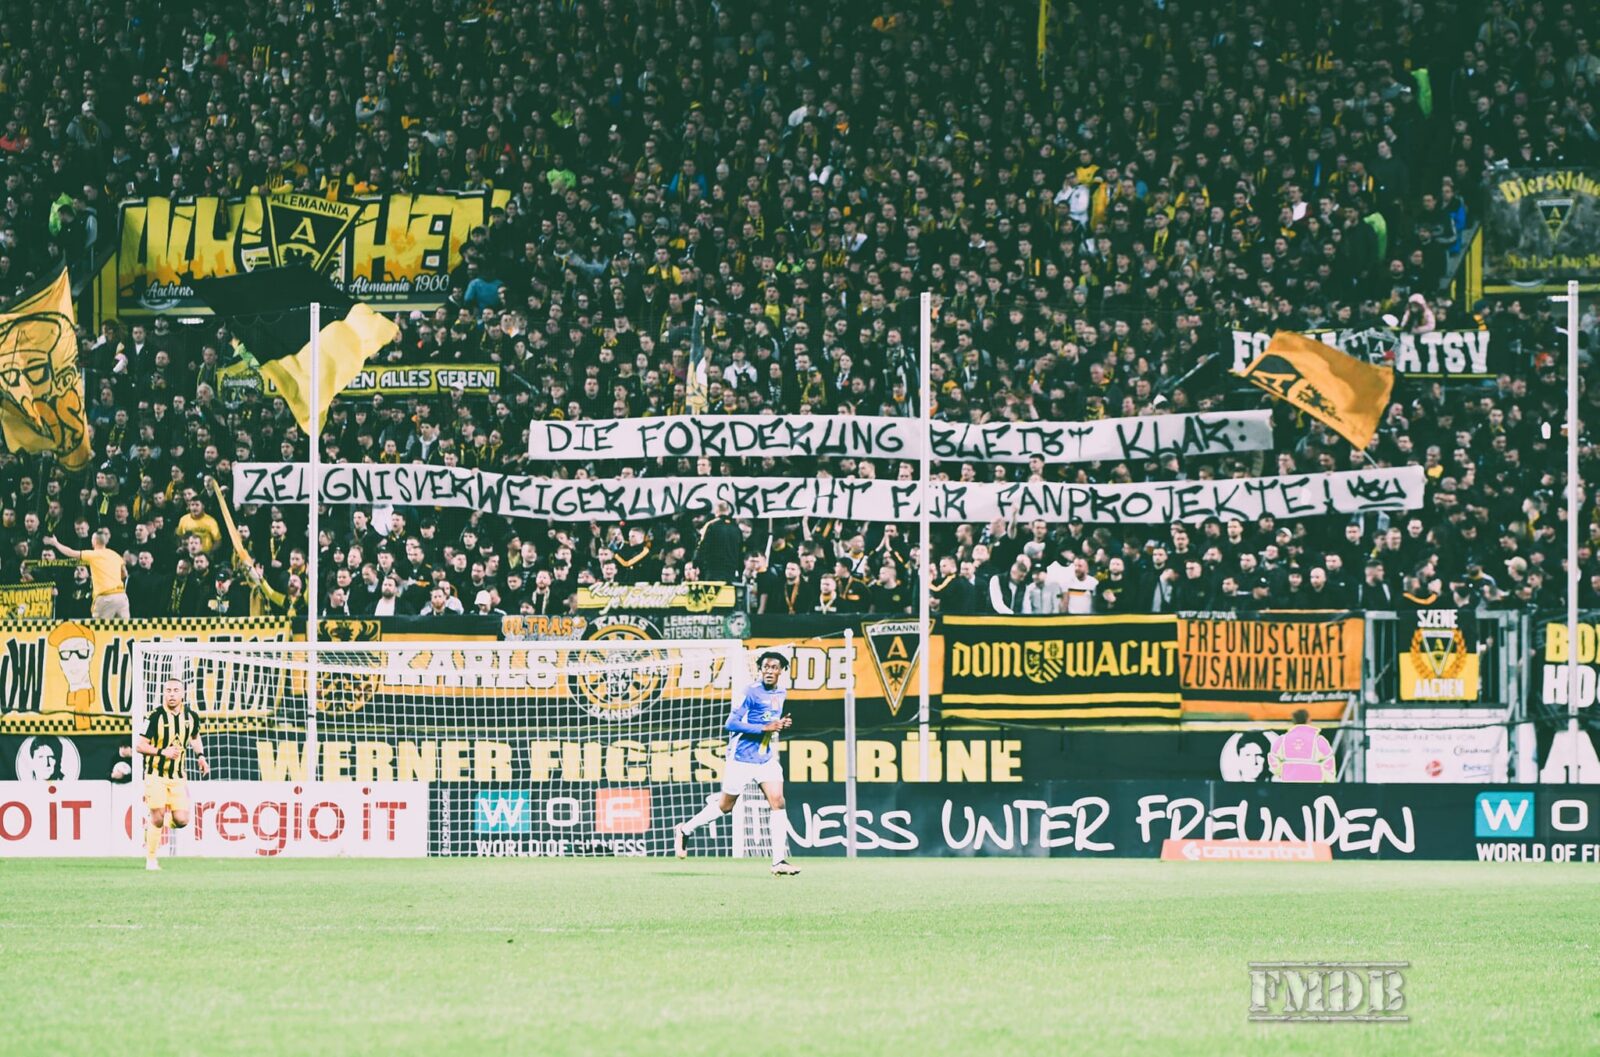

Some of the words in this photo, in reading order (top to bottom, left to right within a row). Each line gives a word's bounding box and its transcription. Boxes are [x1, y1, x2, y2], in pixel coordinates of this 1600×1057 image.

[271, 194, 350, 217] ALEMANNIA
[289, 216, 316, 244] A
[348, 276, 410, 294] Alemannia
[414, 274, 449, 292] 1900
[1396, 330, 1490, 373] ATSV
[380, 370, 430, 388] ALLES
[436, 370, 496, 388] GEBEN!
[546, 421, 619, 453] DIE
[639, 417, 904, 457] FORDERUNG
[929, 421, 1094, 458] BLEIBT
[1116, 414, 1248, 459] KLAR:
[503, 615, 573, 636] ULTRAS
[870, 622, 920, 634] ALEMANNI
[1416, 609, 1458, 628] SZENE
[887, 635, 908, 659] A
[1186, 621, 1346, 656] FREUNDSCHAFT
[1545, 622, 1600, 664] BO
[383, 646, 558, 689] KARLS
[952, 640, 1024, 678] DOM
[1066, 640, 1179, 678] WACHT
[1182, 654, 1346, 690] ZUSAMMENHALT
[1413, 678, 1465, 698] AACHEN
[1542, 664, 1600, 708] HO
[257, 741, 514, 782] WERNER
[531, 740, 727, 782] FUCHS
[778, 732, 1022, 782] RIBÜNE
[194, 785, 345, 857] regio
[361, 786, 408, 841] iT
[704, 792, 920, 850] TNESS
[941, 796, 1115, 852] UNTER
[1136, 795, 1416, 854] FREUNDEN
[475, 839, 541, 857] WORLD
[1476, 843, 1546, 863] WORLD
[1551, 843, 1577, 863] OF
